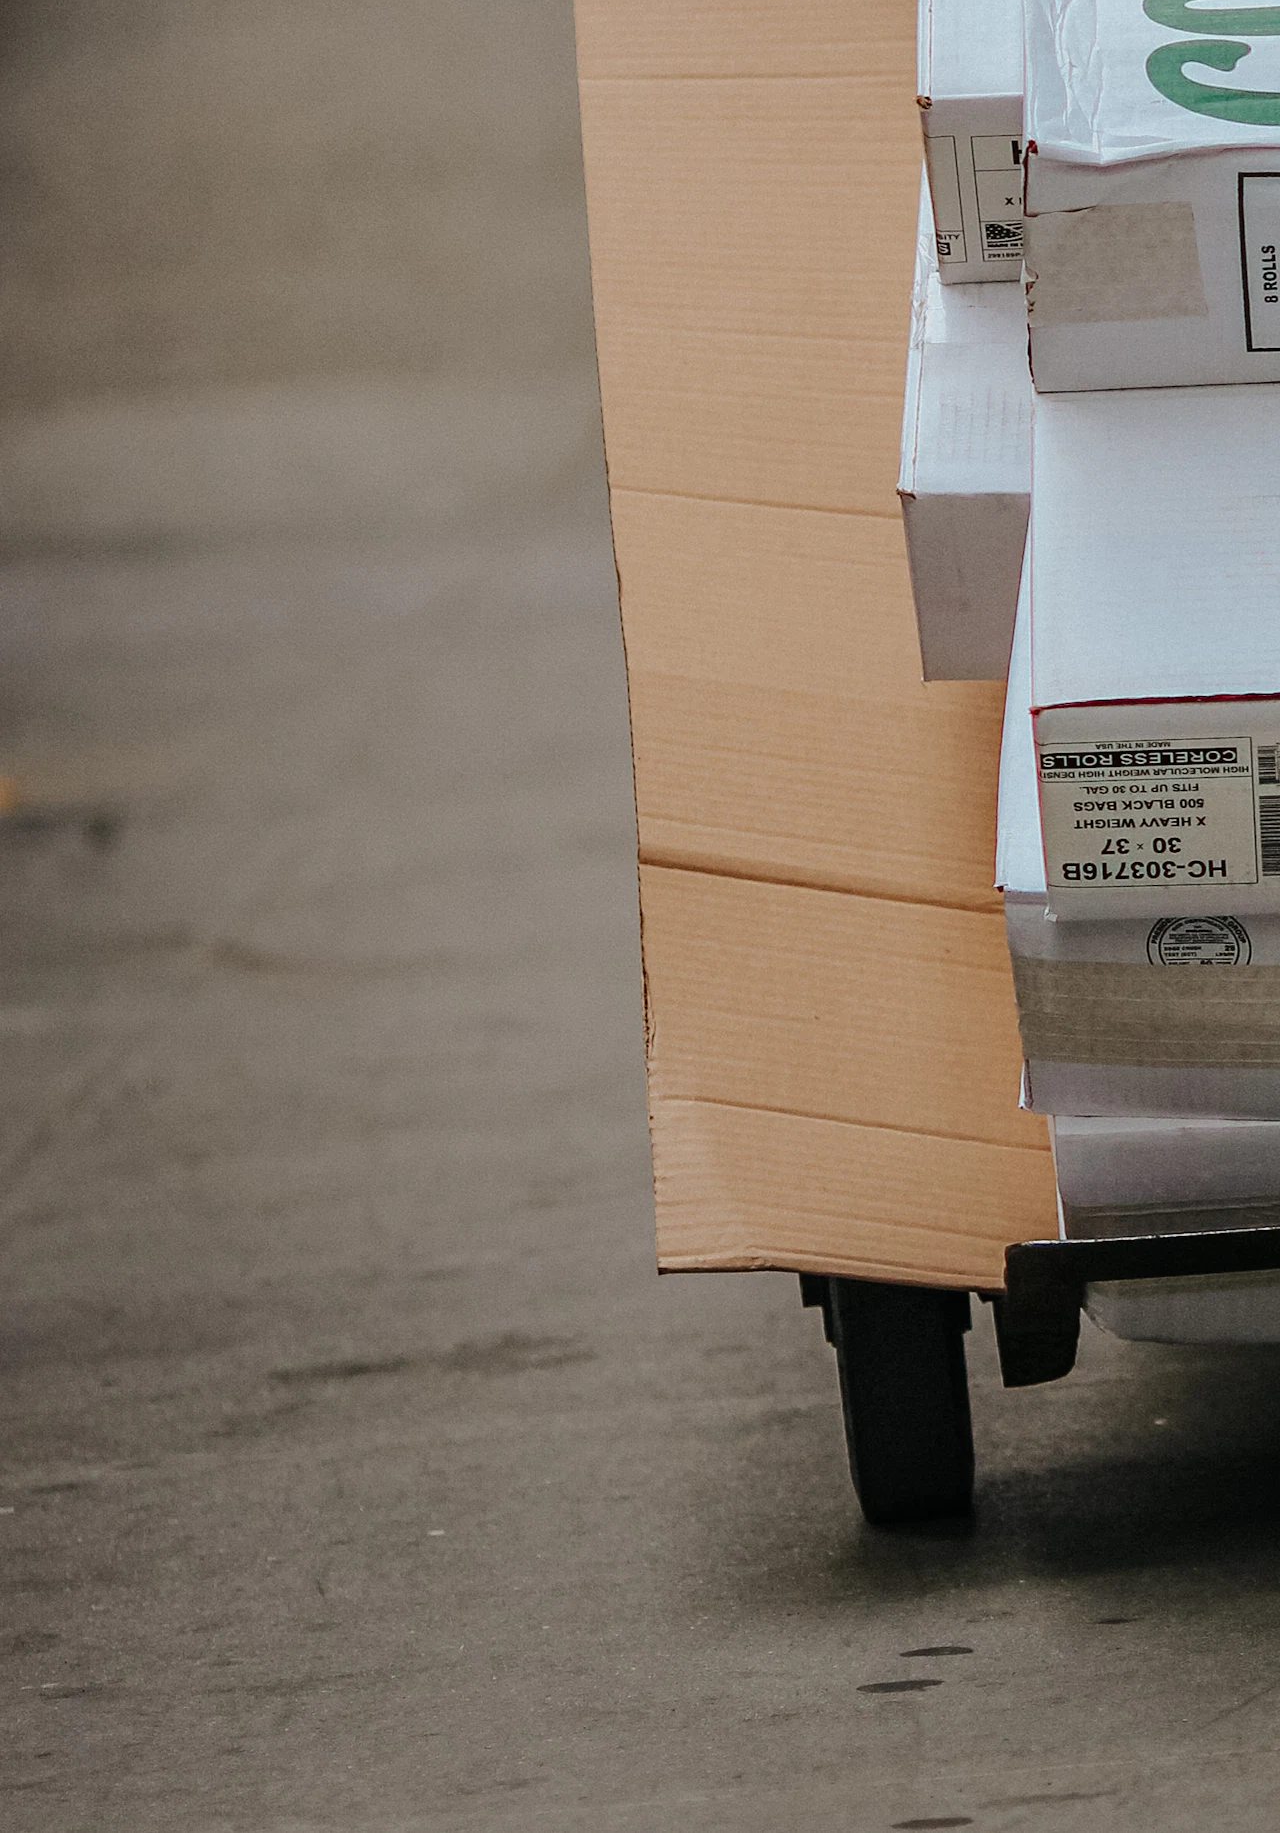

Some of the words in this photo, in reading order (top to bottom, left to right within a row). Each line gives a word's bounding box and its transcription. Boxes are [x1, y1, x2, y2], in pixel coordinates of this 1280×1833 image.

[1260, 245, 1278, 291] ROLLS
[1264, 295, 1279, 304] 8
[1095, 743, 1113, 751] USA
[1115, 742, 1133, 750] THE
[1135, 741, 1144, 749] IN
[1146, 741, 1171, 749] MADE
[1042, 753, 1114, 768] ROLLS
[1120, 748, 1237, 766] CORELESS
[1078, 770, 1106, 779] HIGH
[1108, 768, 1151, 778] WEIGHT
[1153, 767, 1220, 776] MOLECULAR
[1222, 765, 1250, 775] HIGH
[1079, 785, 1109, 796] GAL.
[1112, 785, 1127, 794] 30
[1130, 784, 1148, 794] TO
[1151, 783, 1168, 793] UP
[1172, 783, 1200, 793] FITS
[1072, 800, 1117, 812] BAGS
[1121, 799, 1175, 811] BLACK
[1179, 798, 1205, 809] 500
[1073, 817, 1136, 830] WEIGHT
[1139, 816, 1192, 828] HEAVY
[1195, 815, 1206, 827] X
[1100, 837, 1130, 855] 37
[1152, 836, 1182, 854] 30
[1062, 859, 1228, 881] HC-303716B
